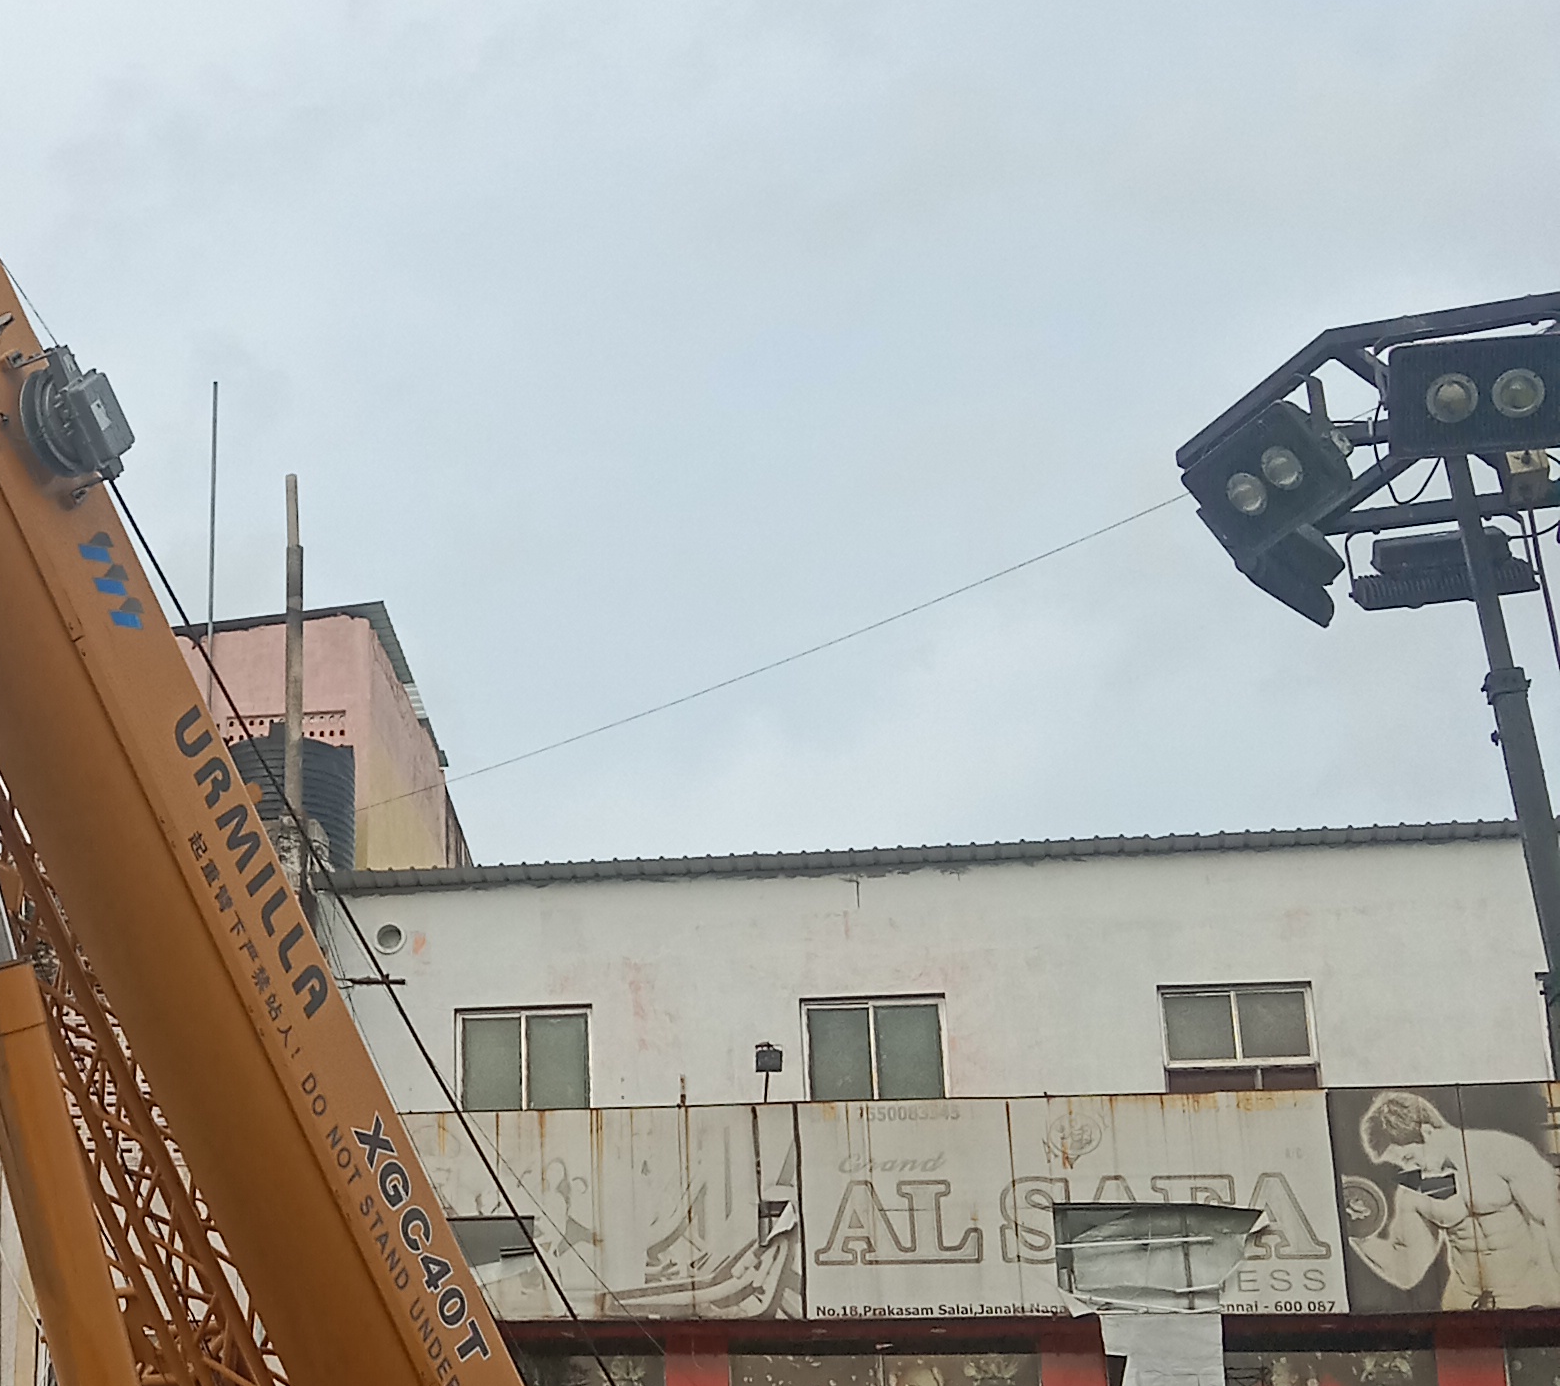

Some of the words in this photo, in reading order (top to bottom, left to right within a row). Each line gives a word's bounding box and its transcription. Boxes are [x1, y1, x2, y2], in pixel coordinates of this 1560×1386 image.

[174, 704, 329, 1019] URMILLA
[300, 1072, 328, 1117] DO
[325, 1126, 362, 1185] NOT
[359, 1193, 411, 1291] STAND
[351, 1110, 492, 1363] XGC40T
[814, 1180, 983, 1265] AL
[1274, 1301, 1303, 1313] 600
[1307, 1301, 1336, 1313] 087
